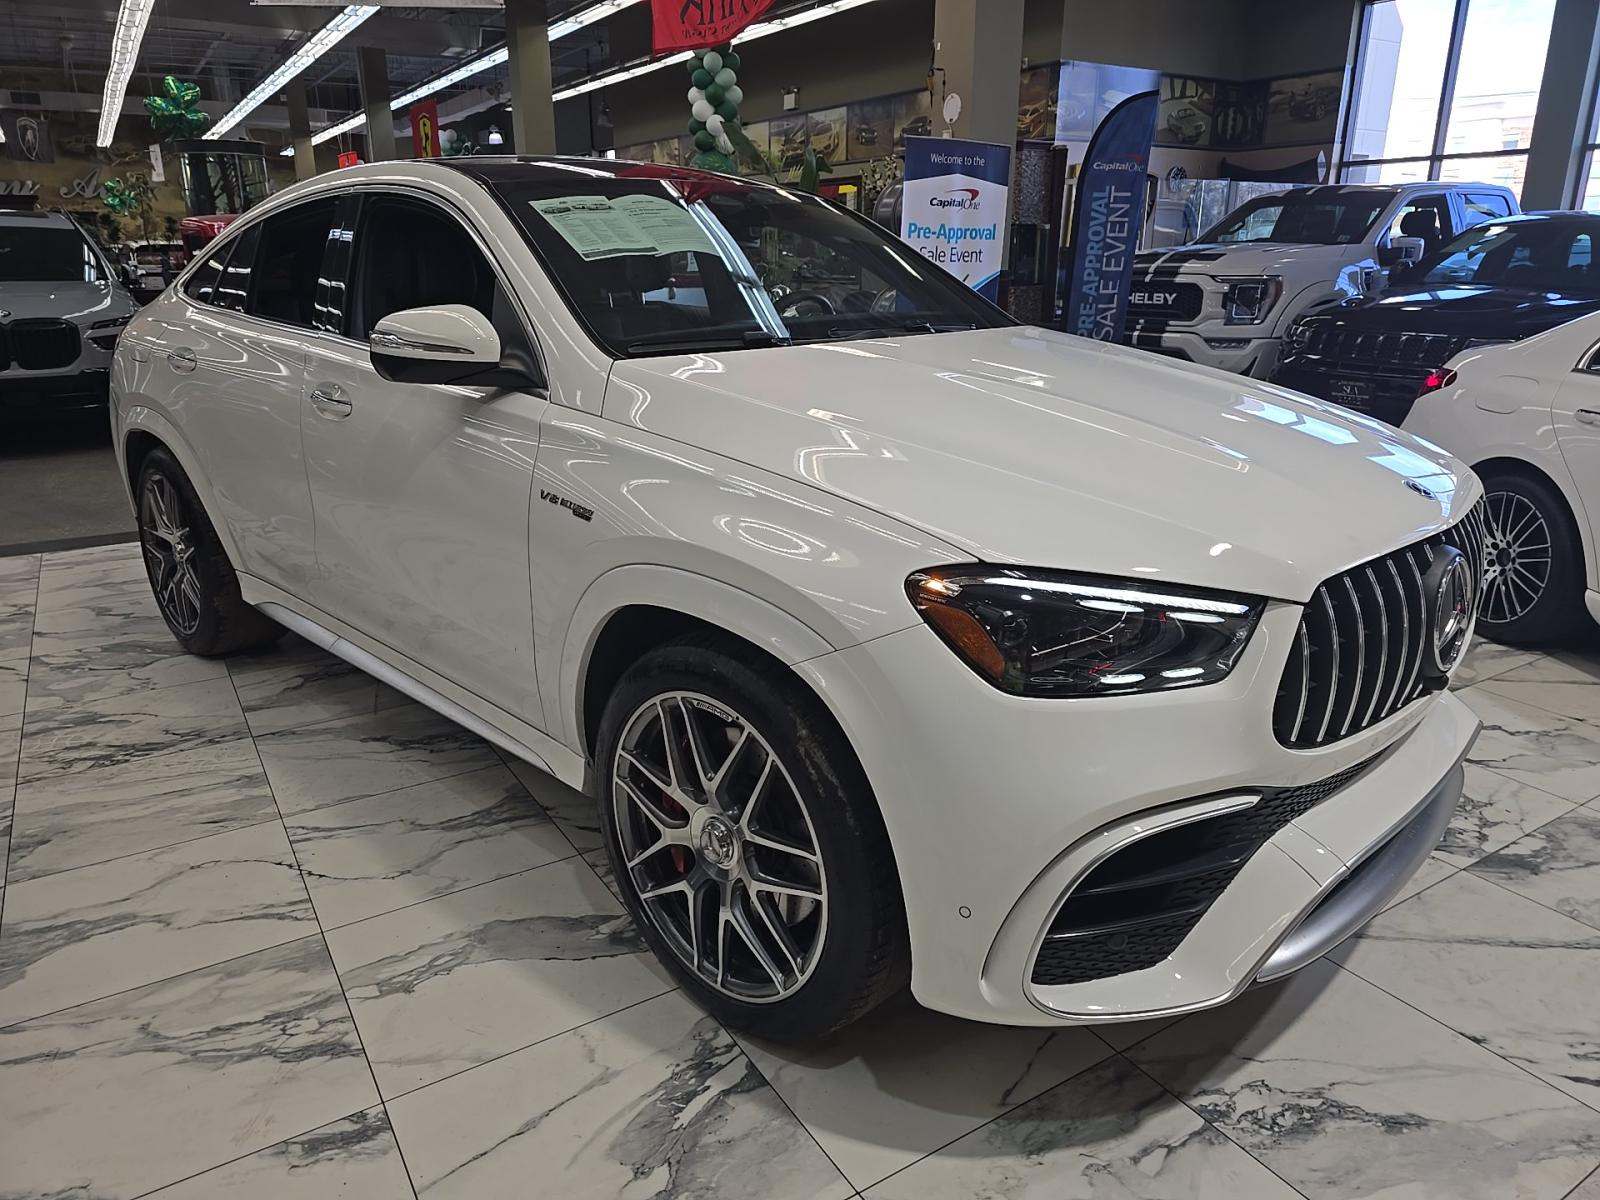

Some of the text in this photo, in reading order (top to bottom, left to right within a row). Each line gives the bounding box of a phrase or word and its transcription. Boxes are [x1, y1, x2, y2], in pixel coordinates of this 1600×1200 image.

[930, 152, 986, 167] Welcome to the
[907, 222, 997, 245] Pre-Approval
[949, 246, 984, 264] Event
[1092, 185, 1133, 341] SALE EVENT
[1128, 292, 1177, 305] HELBY
